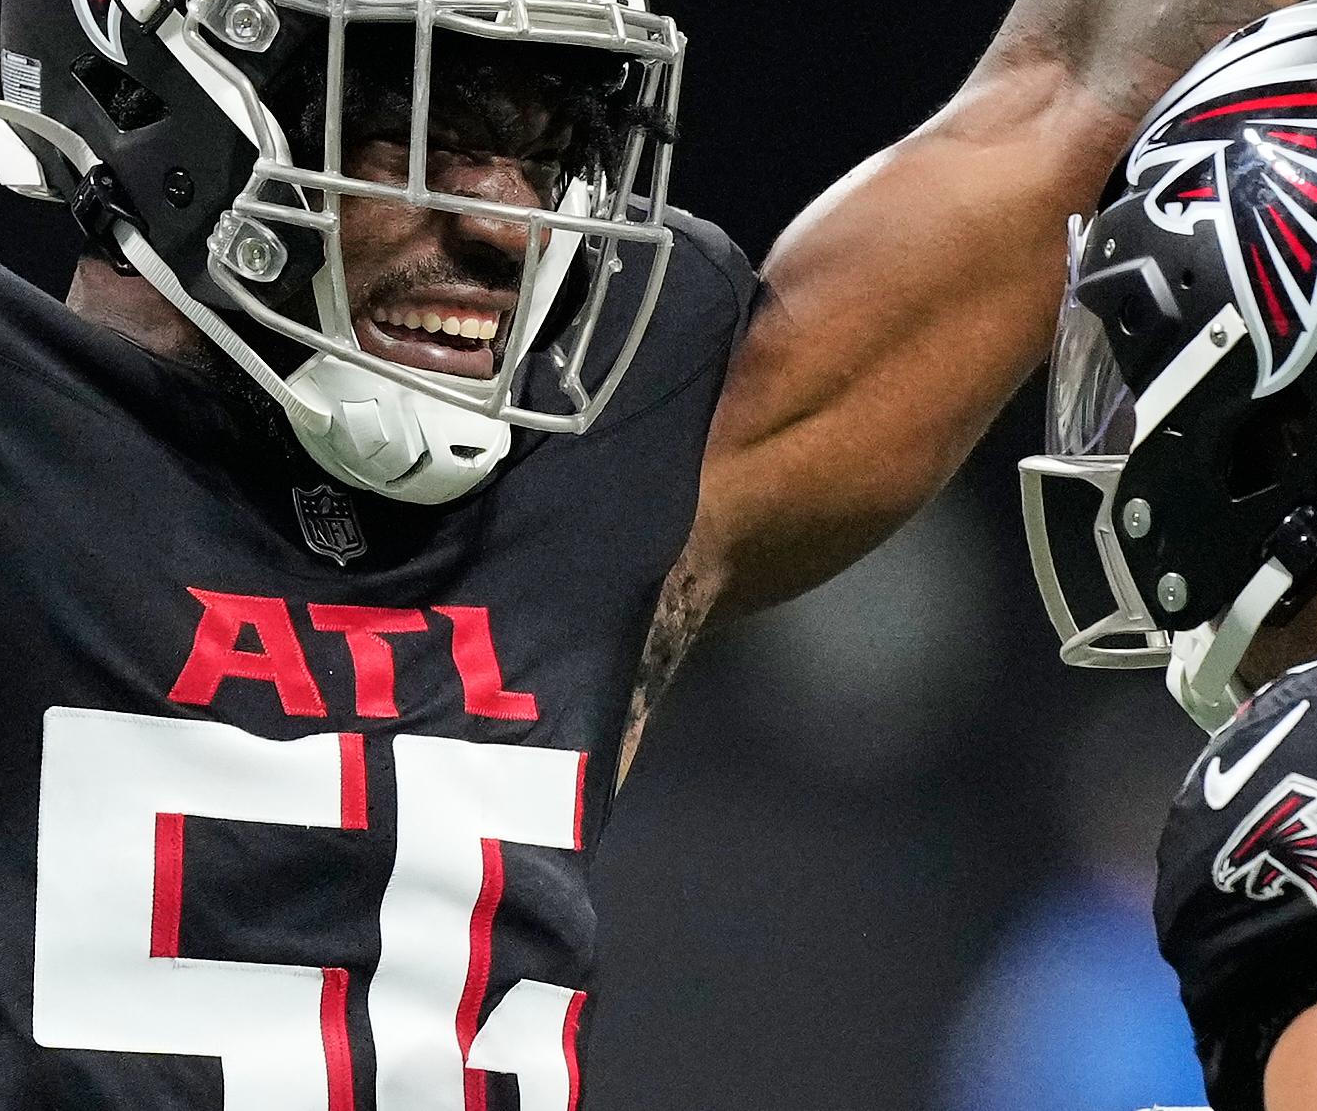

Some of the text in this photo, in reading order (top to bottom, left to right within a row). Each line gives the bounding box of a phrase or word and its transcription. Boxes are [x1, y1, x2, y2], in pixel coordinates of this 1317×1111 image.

[306, 517, 361, 552] NFL
[167, 586, 538, 721] ATL
[32, 706, 588, 1111] 56
